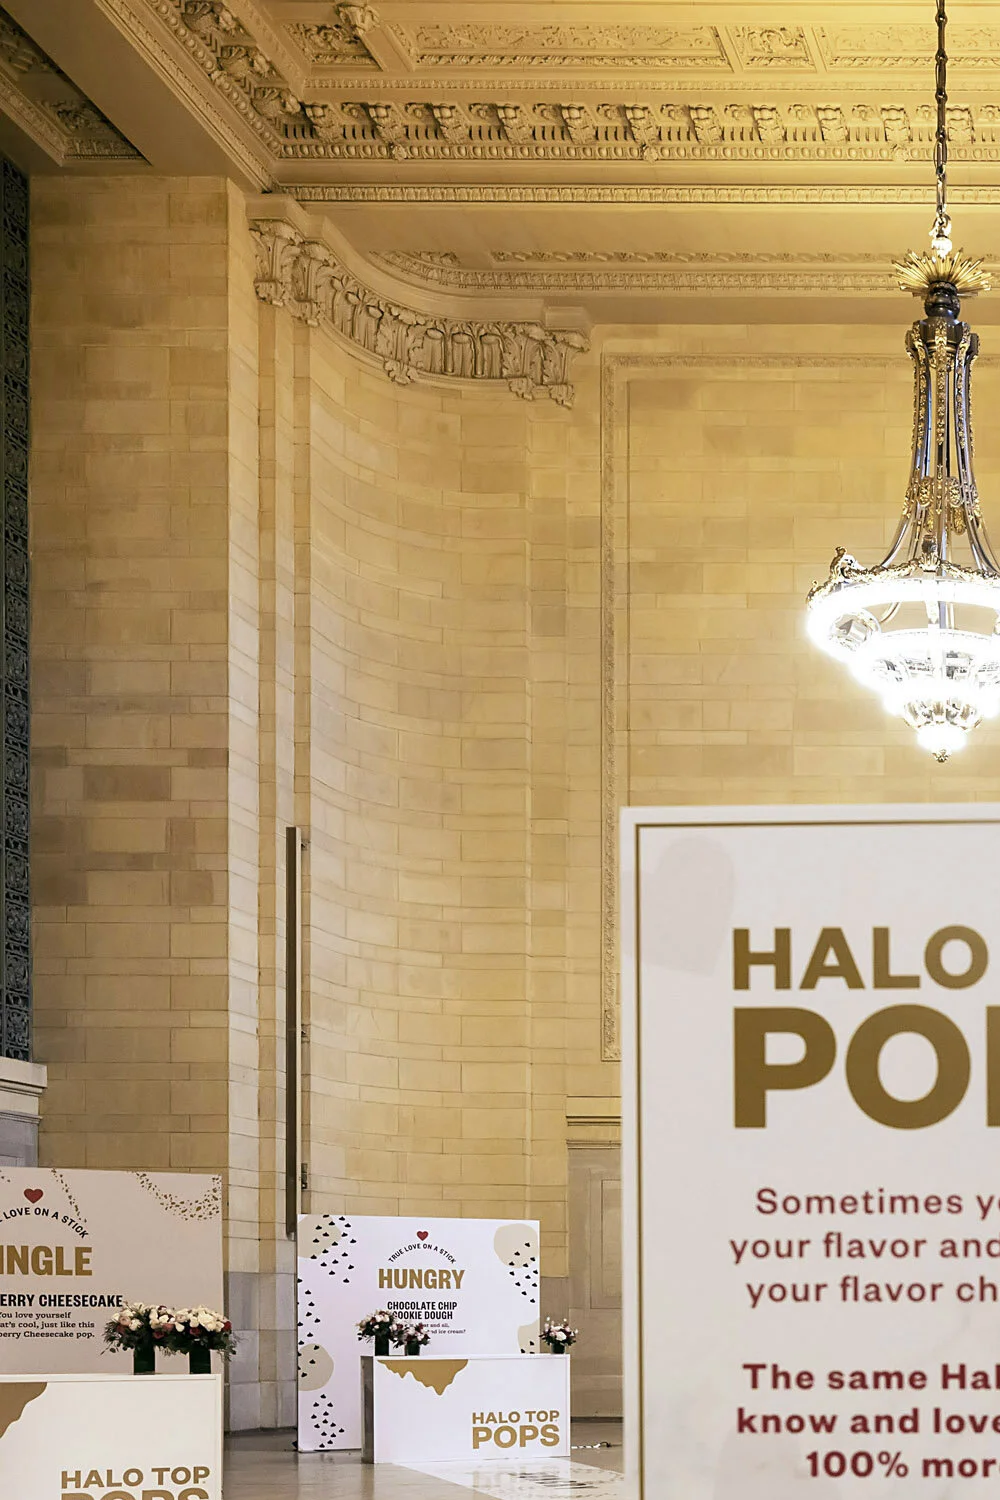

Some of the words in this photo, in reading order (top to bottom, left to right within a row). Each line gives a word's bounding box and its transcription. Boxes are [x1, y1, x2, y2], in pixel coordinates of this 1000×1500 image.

[732, 924, 989, 990] HALO
[755, 1188, 963, 1215] Sometimes
[3, 1207, 31, 1219] LOVE
[34, 1207, 49, 1216] ON
[61, 1216, 89, 1238] STICK
[388, 1249, 404, 1263] TRUE
[405, 1244, 421, 1252] LOVE
[439, 1249, 456, 1264] STICK
[730, 1239, 811, 1265] your
[824, 1232, 927, 1259] flavor
[379, 1269, 465, 1289] HUNGRY
[0, 1294, 35, 1306] ERRY
[39, 1294, 122, 1307] CHEESECAKE
[746, 1283, 828, 1309] your
[841, 1276, 943, 1303] flavor
[36, 1312, 71, 1320] yourself
[387, 1302, 436, 1310] CHOCOLATE
[438, 1302, 457, 1310] CHIP
[393, 1311, 422, 1319] COOKIE
[424, 1311, 452, 1319] DOUGH
[743, 1363, 814, 1390] The
[828, 1371, 928, 1390] same
[472, 1411, 520, 1424] HALO
[738, 1407, 837, 1434] know
[850, 1407, 919, 1434] and
[472, 1424, 560, 1449] POPS
[806, 1450, 909, 1479] 100%
[61, 1468, 144, 1489] HALO
